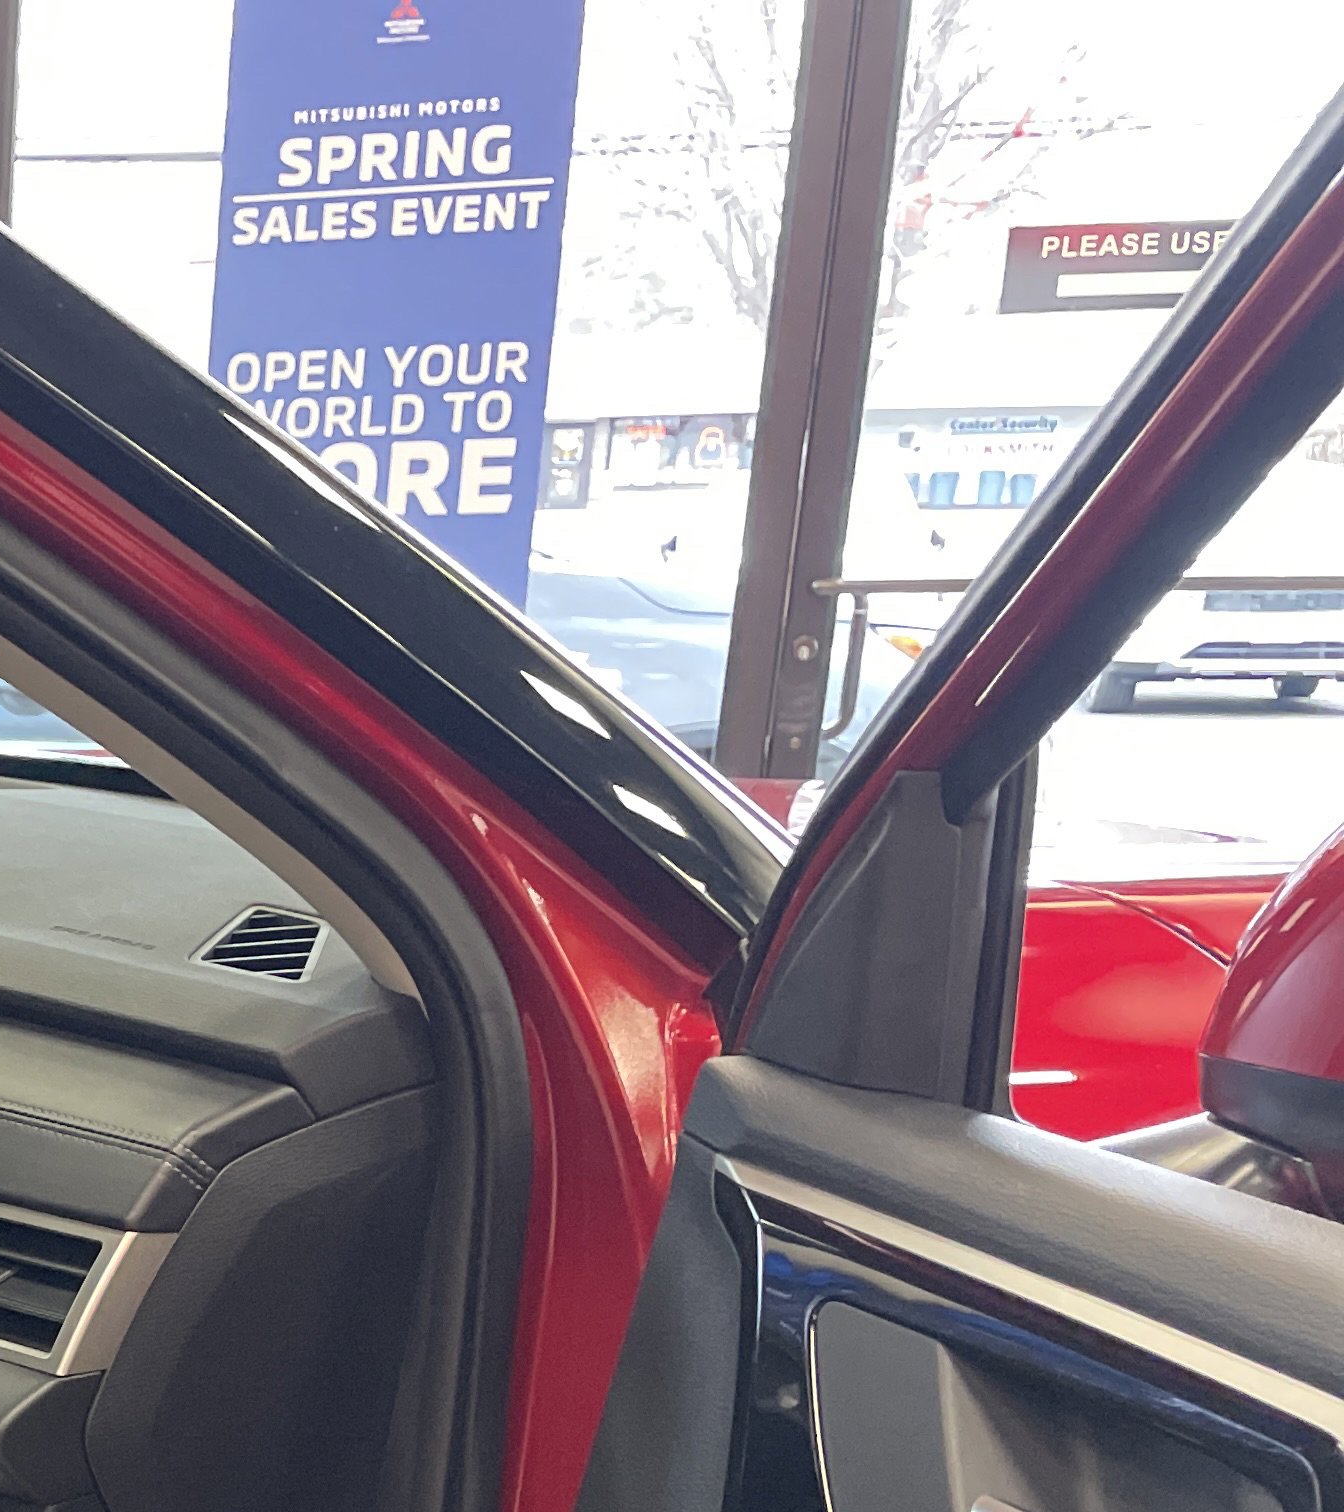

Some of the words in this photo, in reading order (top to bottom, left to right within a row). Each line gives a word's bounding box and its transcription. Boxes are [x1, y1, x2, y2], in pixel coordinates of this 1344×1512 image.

[294, 103, 410, 125] MITSUBISHI
[418, 96, 502, 117] MOTORS
[277, 124, 512, 188] SPRING
[232, 200, 378, 246] SALES
[390, 190, 551, 237] EVENT
[1040, 232, 1161, 259] PLEASE
[226, 347, 366, 395] OPEN
[383, 341, 530, 388] YOUR
[442, 389, 514, 434] TO
[318, 437, 518, 516] ORE
